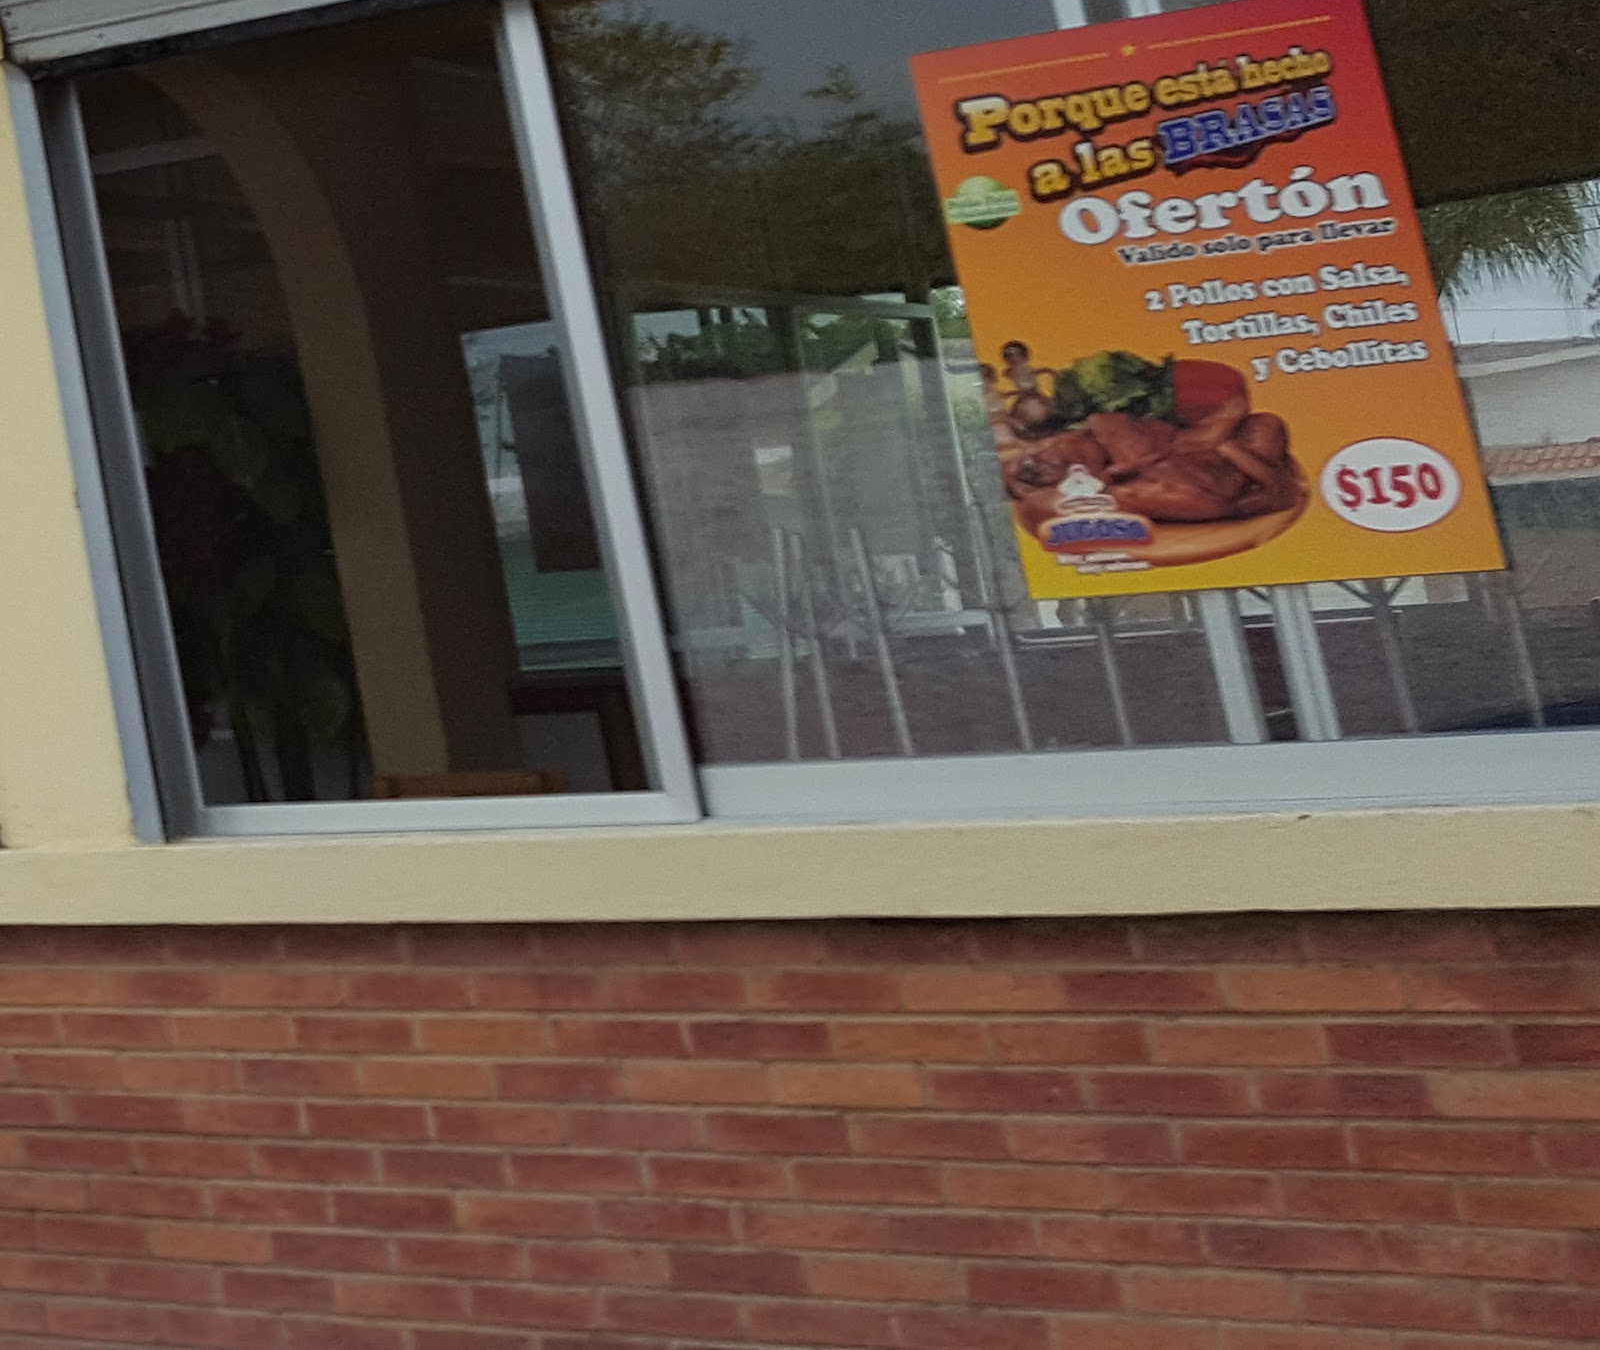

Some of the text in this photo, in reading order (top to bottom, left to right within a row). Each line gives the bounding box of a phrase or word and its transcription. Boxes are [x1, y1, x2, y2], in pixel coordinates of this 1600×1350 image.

[958, 82, 1151, 149] Porque
[1030, 85, 1336, 198] a las BRASAS
[1058, 166, 1390, 245] Ofertón
[1202, 233, 1251, 256] solo
[1257, 227, 1316, 255] para
[1317, 217, 1398, 242] llevar
[1144, 289, 1166, 312] 2
[1167, 279, 1259, 310] Pollos
[1260, 274, 1316, 298] con
[1323, 299, 1420, 330] Chiles
[1251, 339, 1431, 382] y Cebollitas
[1334, 461, 1444, 513] $150
